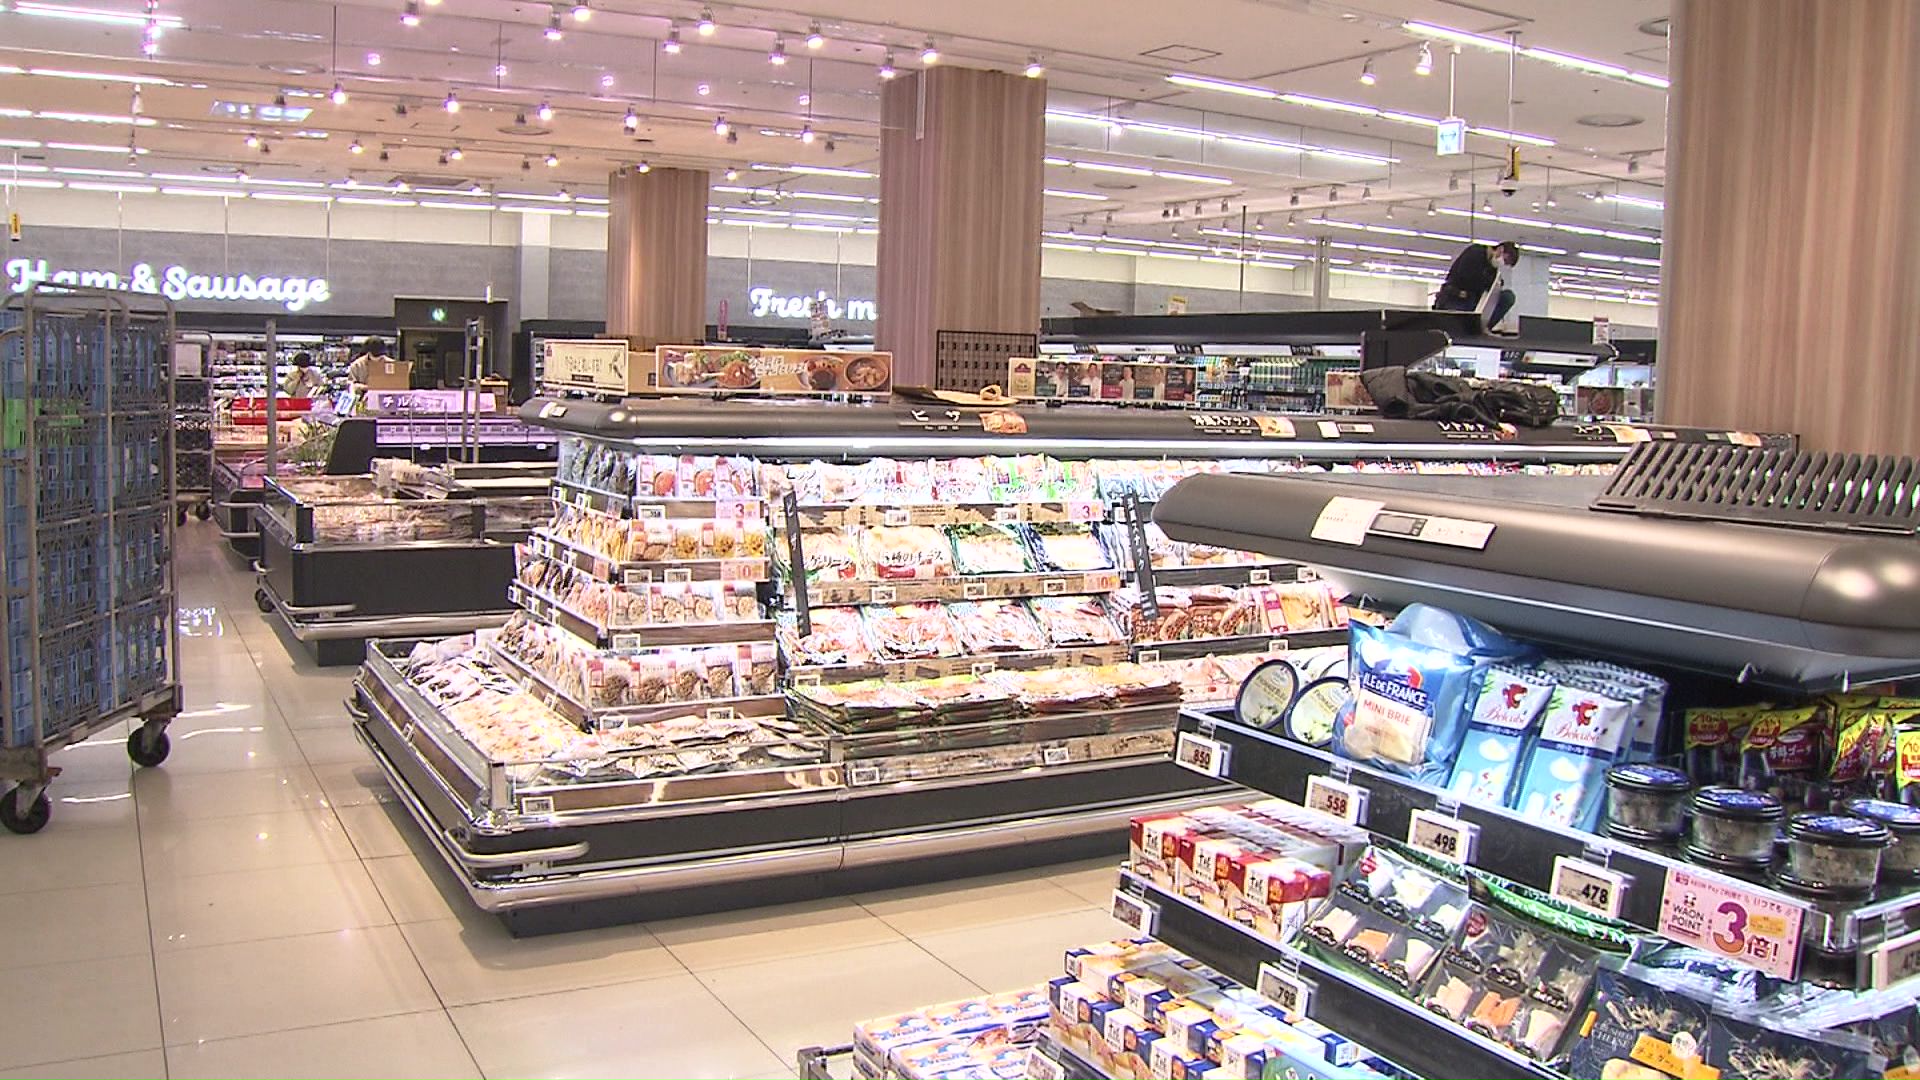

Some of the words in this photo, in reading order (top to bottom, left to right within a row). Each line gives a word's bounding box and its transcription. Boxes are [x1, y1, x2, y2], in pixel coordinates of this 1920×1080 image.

[5, 257, 127, 294] Ham
[130, 262, 158, 294] &
[161, 264, 331, 312] Sausage
[1386, 681, 1428, 706] FRANCE
[1363, 699, 1385, 716] MINI
[1387, 709, 1411, 726] BRIE
[1193, 750, 1210, 765] 850
[1326, 795, 1347, 813] 558
[1434, 832, 1457, 850] 498
[1581, 883, 1608, 904] 478
[1673, 903, 1704, 922] WAON
[1672, 914, 1702, 932] POINT
[1277, 986, 1297, 1006] 798
